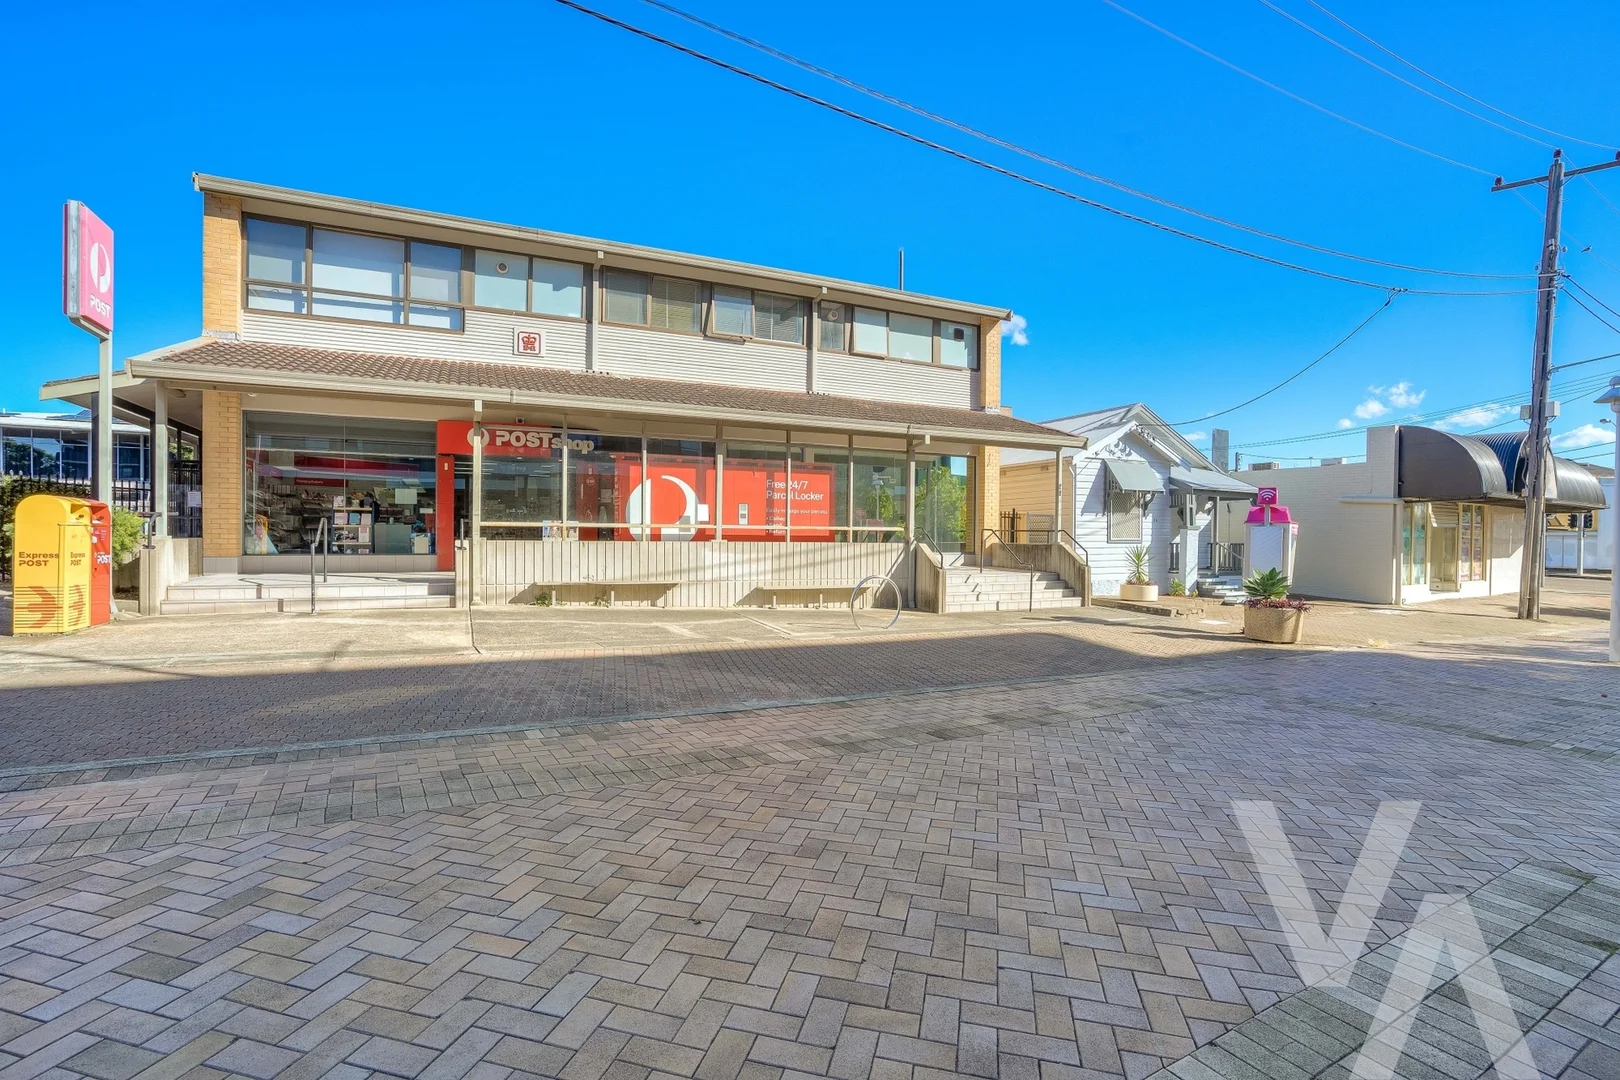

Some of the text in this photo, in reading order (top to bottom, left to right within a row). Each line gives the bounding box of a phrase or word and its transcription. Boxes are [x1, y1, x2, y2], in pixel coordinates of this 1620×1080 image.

[90, 293, 111, 318] POST
[766, 480, 786, 489] Free
[766, 491, 824, 500] Parcl Locker
[19, 551, 60, 559] Express
